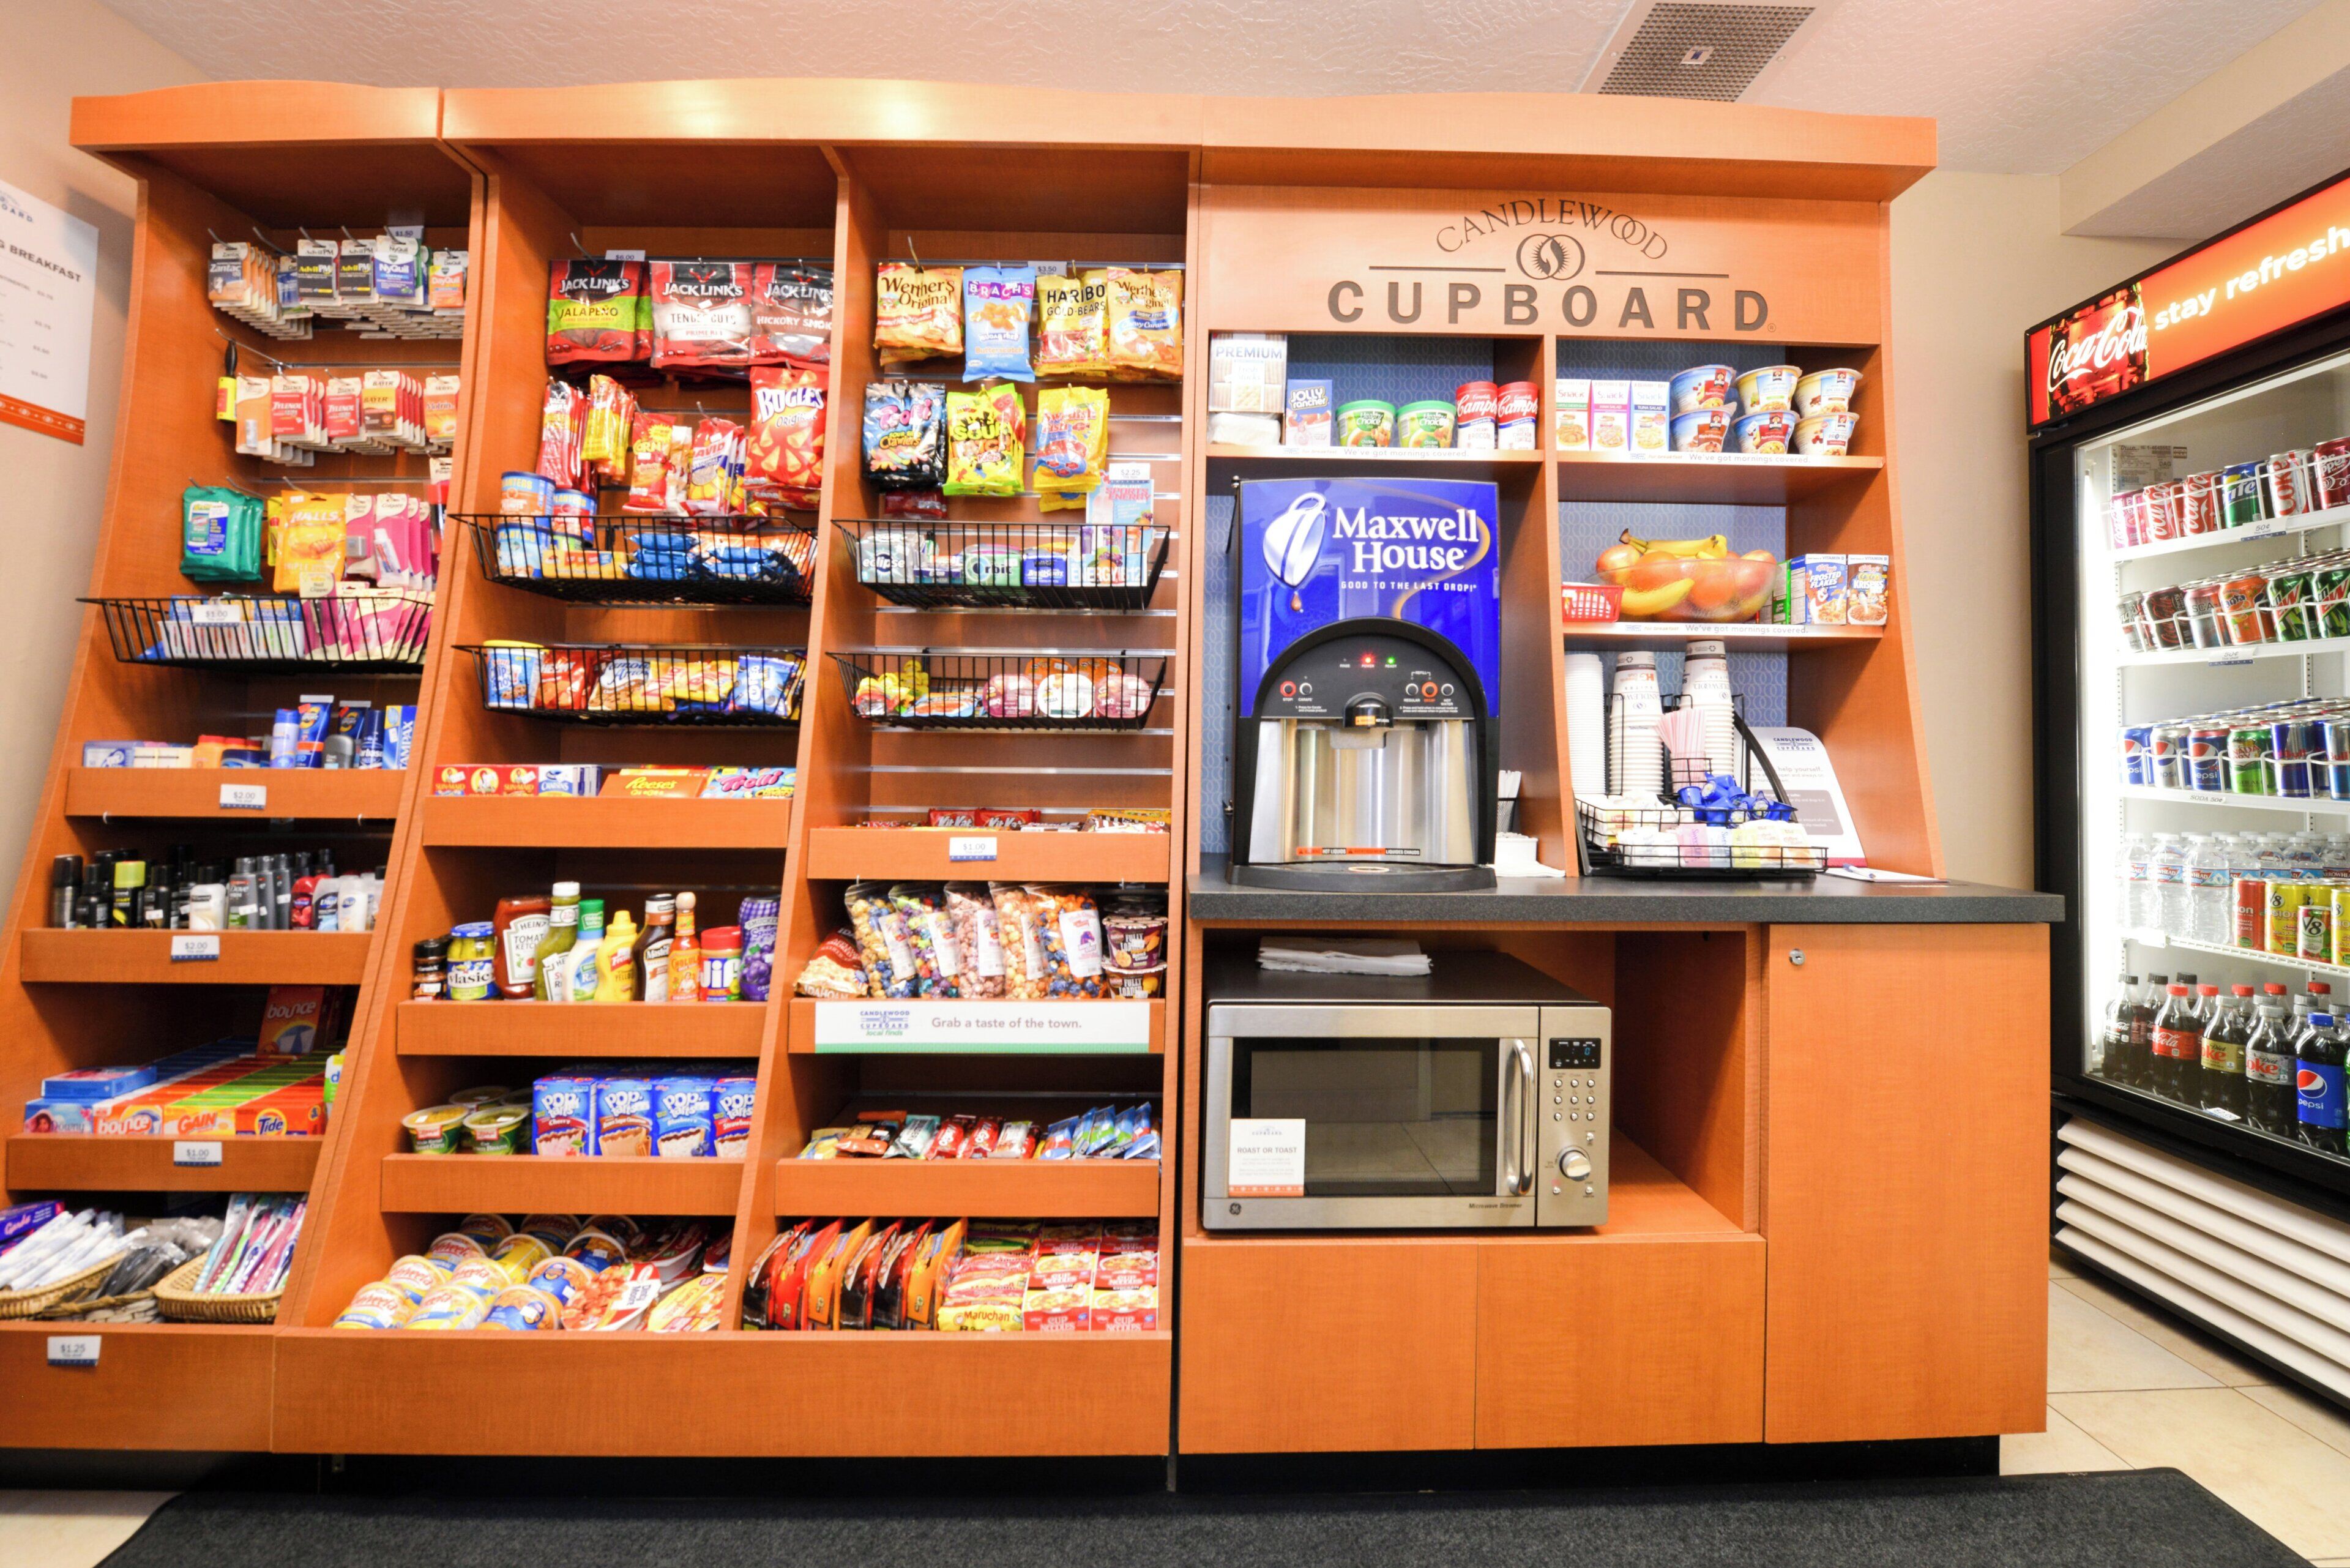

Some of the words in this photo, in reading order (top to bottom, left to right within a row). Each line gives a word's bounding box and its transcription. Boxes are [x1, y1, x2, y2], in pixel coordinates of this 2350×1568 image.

[1436, 197, 1668, 259] CANDLEWOOD
[10, 245, 81, 282] BREAKFAST
[211, 264, 241, 273] Zantac
[379, 263, 409, 274] NyQuil
[432, 277, 460, 285] DayQuil
[559, 279, 588, 293] JACK
[881, 277, 955, 295] Werther's
[663, 284, 698, 296] JACK
[699, 284, 743, 297] LINK'S
[765, 285, 796, 299] JACK
[968, 282, 1032, 297] BRACH'S
[1047, 285, 1105, 303] HARIBO
[898, 291, 952, 310] Original
[1327, 280, 1769, 331] CUPBOARD
[1046, 301, 1106, 317] GOLD-BEARS
[2154, 286, 2217, 331] stay
[757, 316, 799, 326] HICKORY
[1215, 346, 1282, 359] PREMIUM
[2048, 305, 2148, 393] Coca-Cola
[1291, 387, 1326, 401] JOLLY
[755, 387, 824, 423] BUGLES
[1291, 397, 1328, 409] rancher
[953, 422, 1010, 440] SOUR
[291, 511, 338, 523] HALLS
[1332, 506, 1479, 542] Maxwell
[863, 558, 906, 570] eclipse
[1352, 541, 1465, 573] House
[1810, 571, 1841, 582] FROSTED
[1414, 582, 1439, 591] LAST
[1810, 580, 1837, 588] FLAKES
[1685, 624, 1710, 633] We've
[1714, 625, 1728, 635] got
[1731, 625, 1770, 635] mornings
[400, 721, 413, 769] TAMPAX
[722, 771, 783, 792] Trolli
[938, 816, 955, 827] Kit
[955, 816, 972, 827] Kat
[2302, 916, 2324, 935] V8
[267, 1001, 316, 1020] bounce
[931, 1018, 961, 1028] Grab
[976, 1018, 1005, 1028] taste
[1009, 1018, 1021, 1028] of
[1025, 1018, 1044, 1028] the
[1048, 1019, 1082, 1029] town.
[2298, 1099, 2324, 1111] pepsi
[98, 1115, 151, 1134] bounce
[178, 1112, 217, 1135] GAIN
[258, 1117, 283, 1134] Tide
[187, 1148, 209, 1157] $1.00
[964, 1310, 1009, 1321] Maruchan
[1047, 1316, 1067, 1324] CUP
[61, 1343, 86, 1354] $1.25
